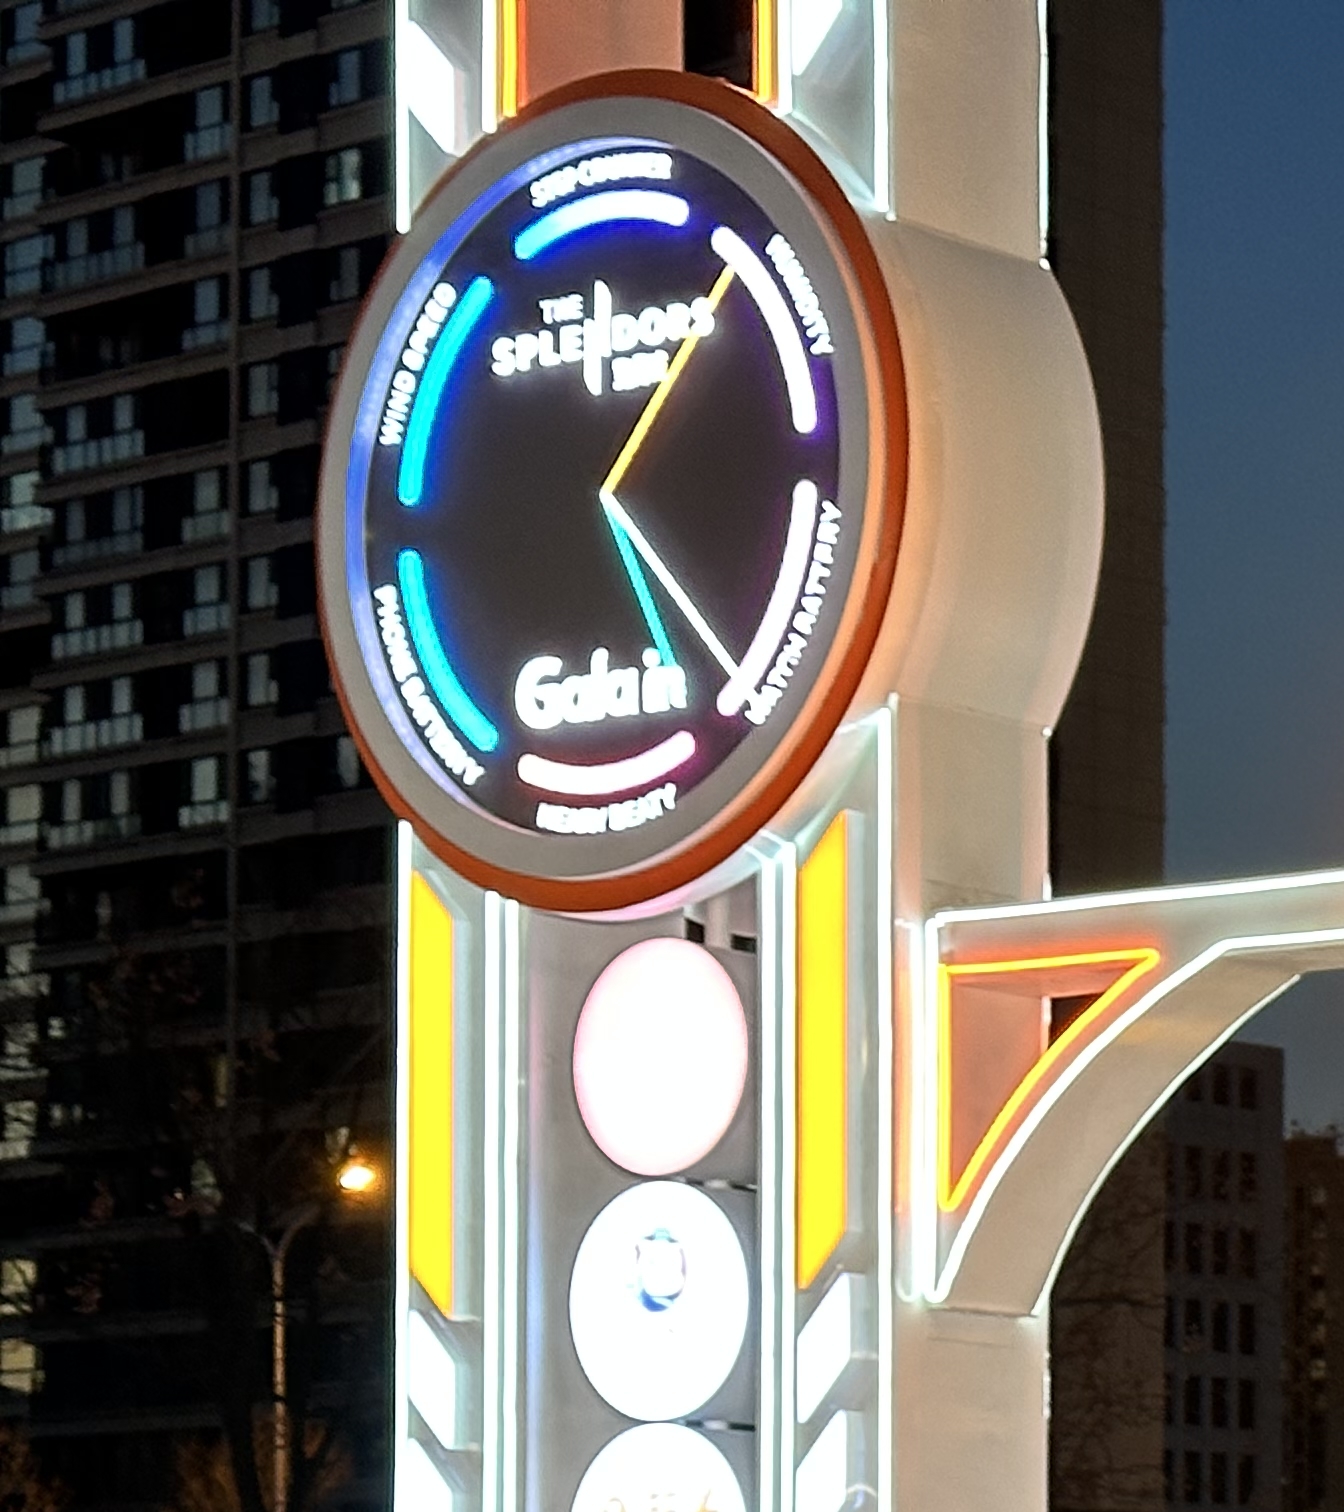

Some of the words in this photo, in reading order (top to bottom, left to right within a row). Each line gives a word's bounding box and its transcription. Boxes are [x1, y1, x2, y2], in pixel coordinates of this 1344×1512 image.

[491, 279, 715, 396] SPLENDORS
[765, 233, 835, 355] HUMIDITY
[379, 370, 416, 446] WIND
[402, 282, 457, 371] SPEED
[792, 500, 842, 635] BATTERY
[401, 676, 486, 786] BATTERY
[514, 647, 640, 730] Gala
[642, 647, 688, 714] in
